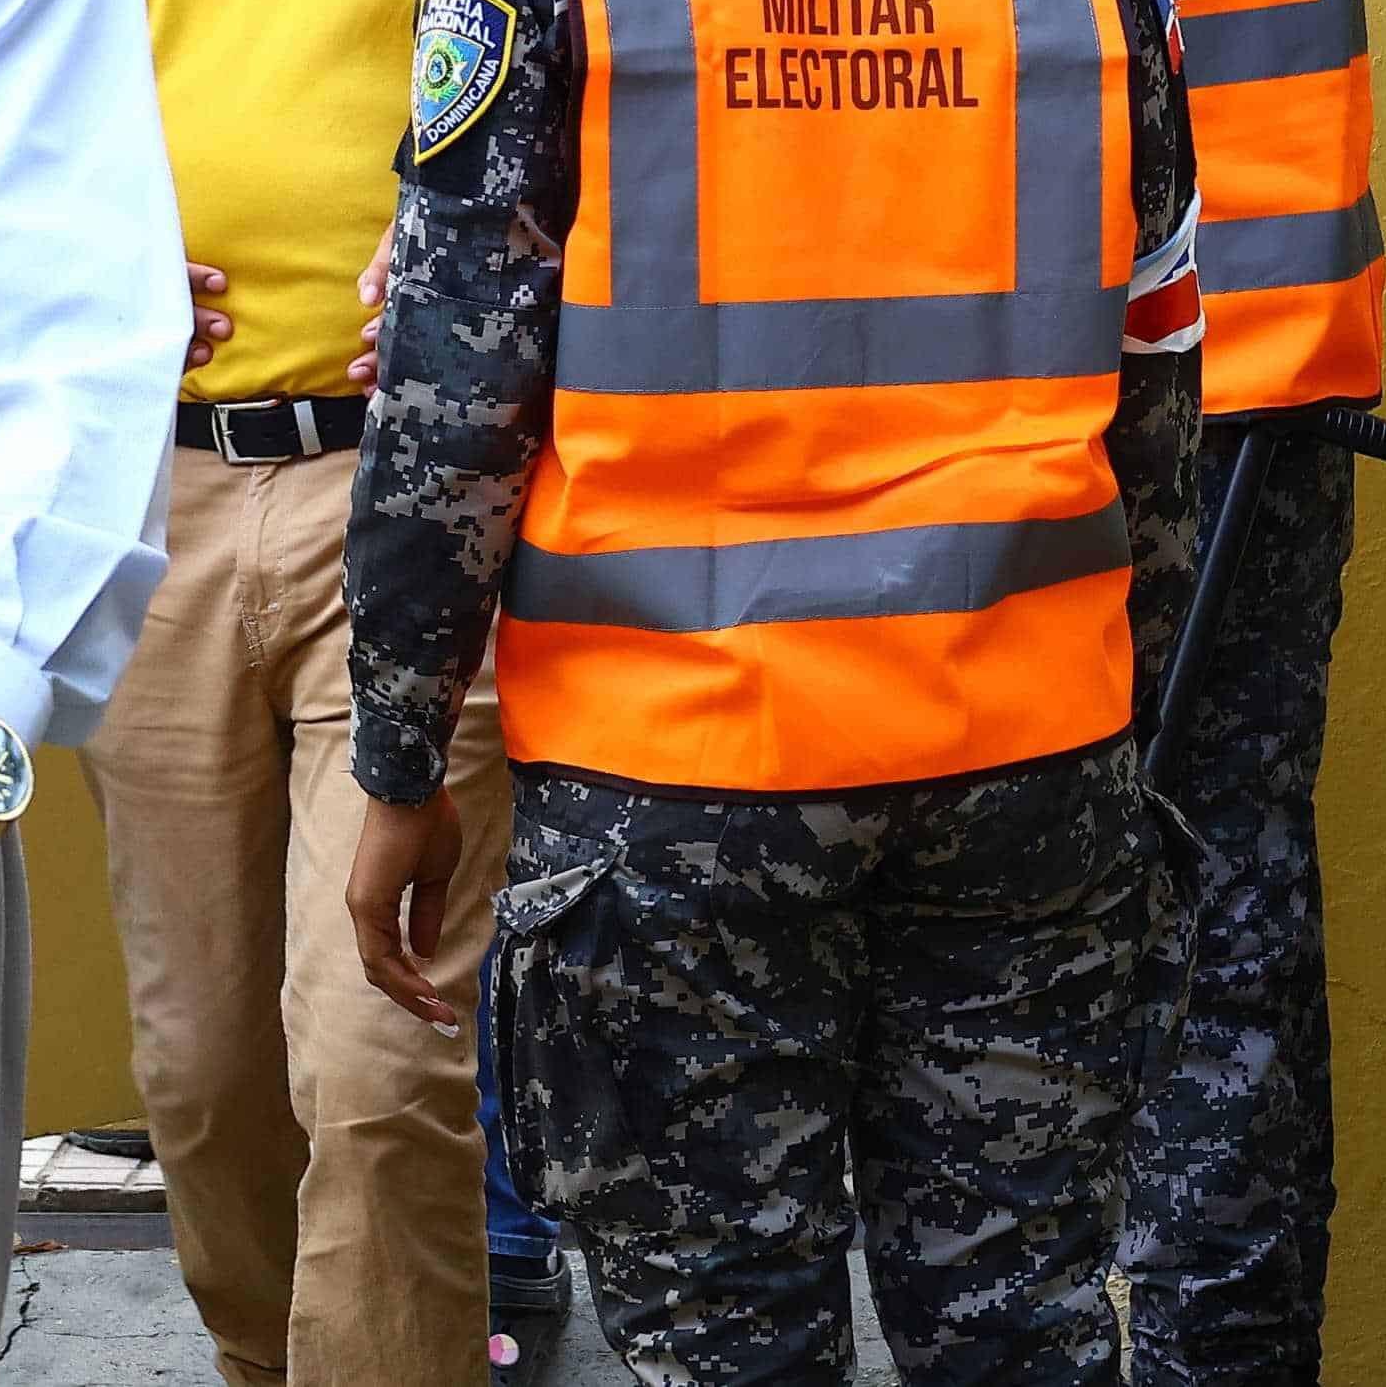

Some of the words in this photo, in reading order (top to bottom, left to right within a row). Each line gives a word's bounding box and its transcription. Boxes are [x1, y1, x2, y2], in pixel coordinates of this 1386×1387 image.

[420, 10, 496, 49] NACIONAL
[426, 58, 500, 143] DOMINICANA
[725, 46, 979, 111] ELECTORAL
